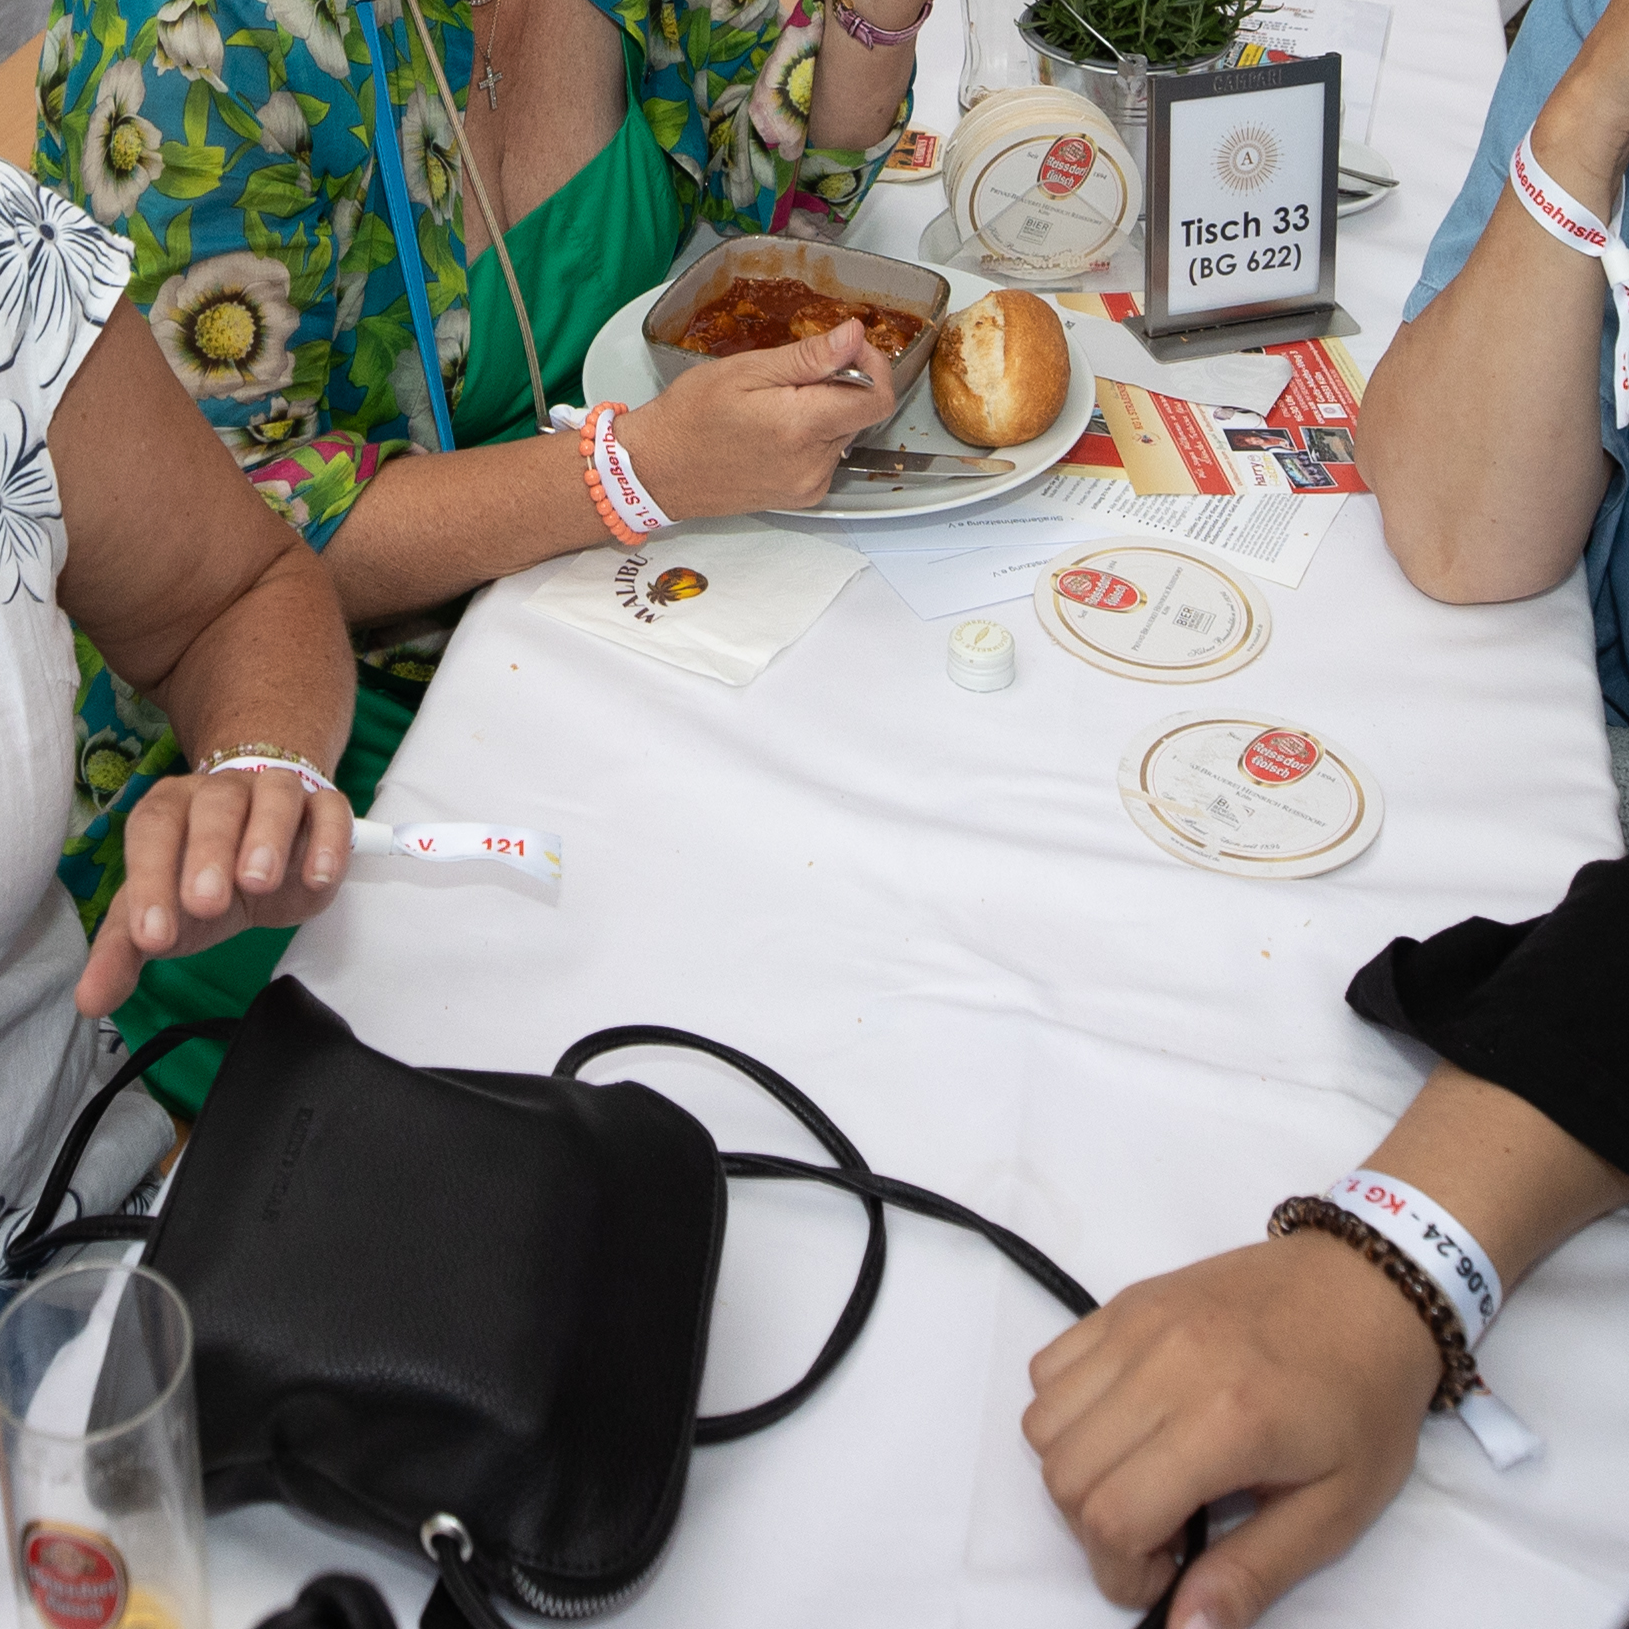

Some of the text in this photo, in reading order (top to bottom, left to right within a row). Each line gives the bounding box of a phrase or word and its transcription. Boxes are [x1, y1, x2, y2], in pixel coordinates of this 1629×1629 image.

[1212, 69, 1283, 93] CAMPARI
[1046, 156, 1089, 177] Reissdorf
[1025, 218, 1050, 232] BIER
[1181, 204, 1310, 247] Tisch 33
[1189, 244, 1302, 287] (BG 622)
[1251, 461, 1268, 487] harry
[614, 553, 665, 625] MALIBU
[1176, 606, 1195, 627] BIER
[1250, 755, 1292, 780] Kölsch
[1252, 741, 1311, 774] Reissdorf
[481, 837, 526, 858] 121
[1364, 1185, 1407, 1217] KG
